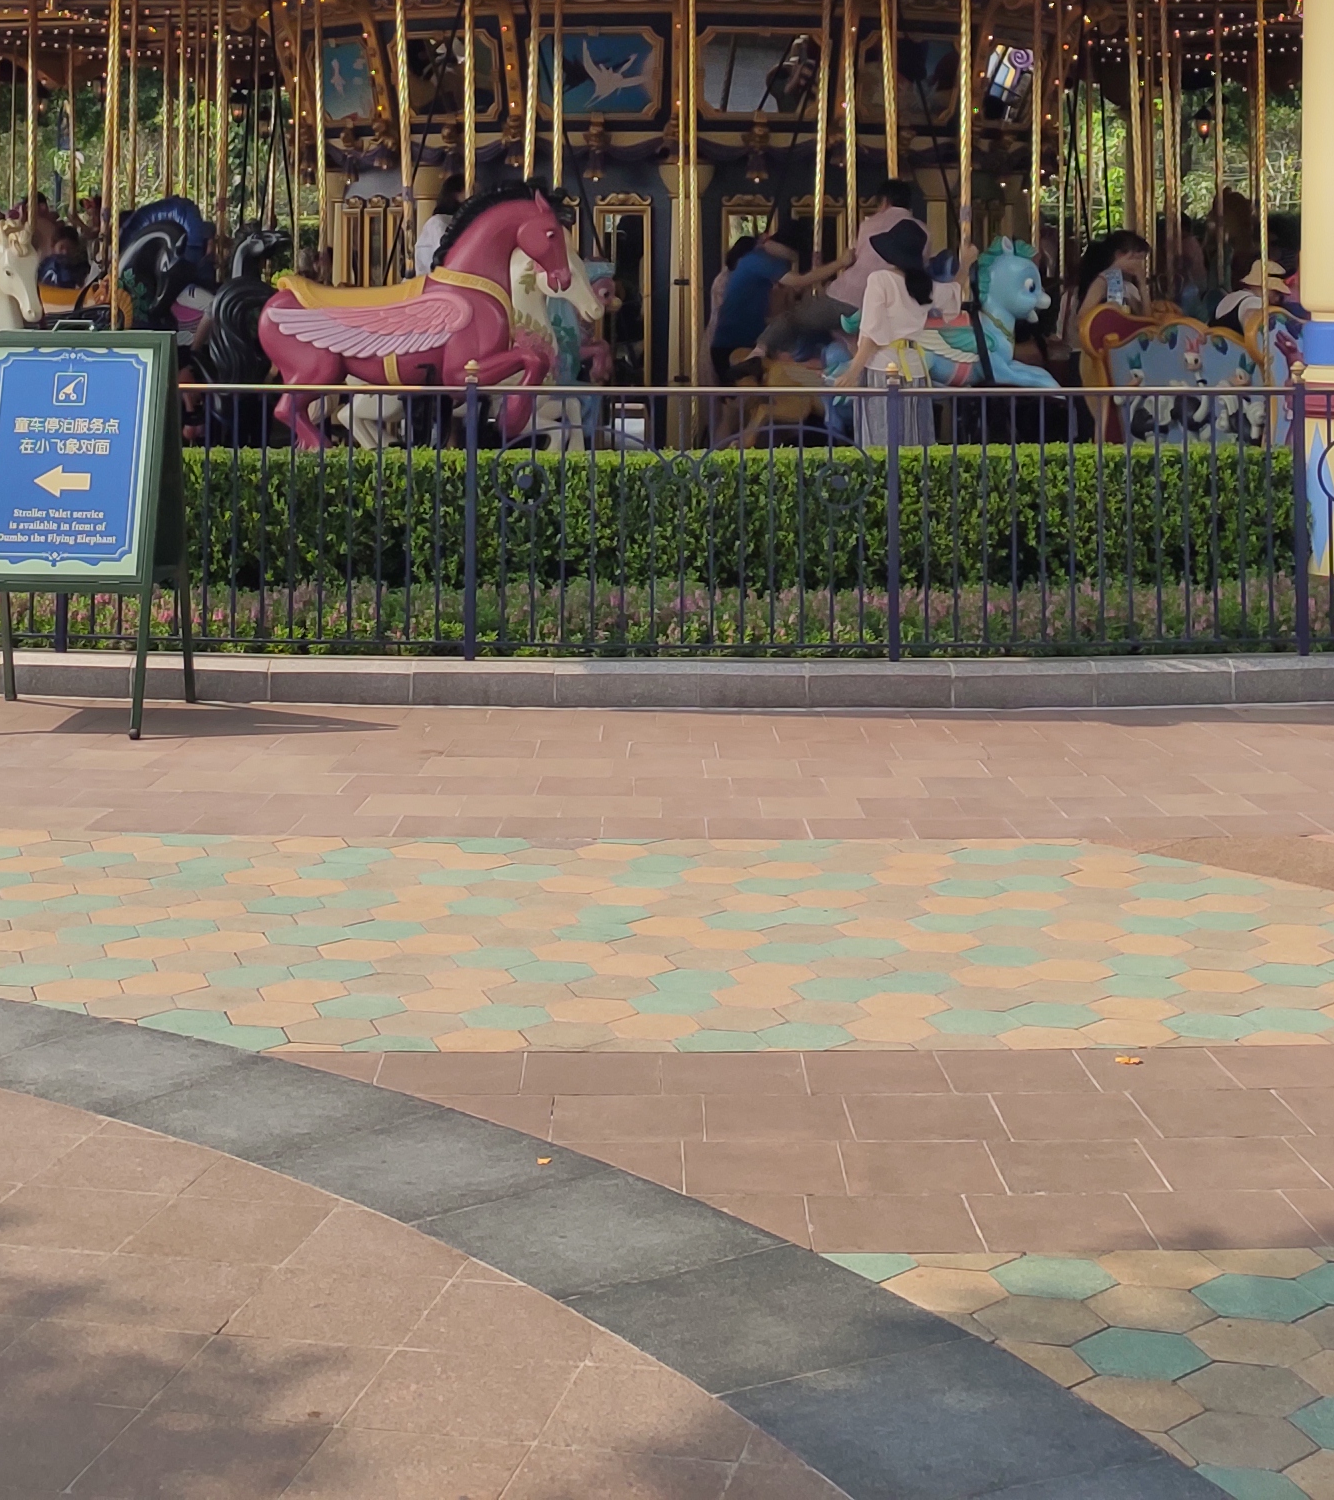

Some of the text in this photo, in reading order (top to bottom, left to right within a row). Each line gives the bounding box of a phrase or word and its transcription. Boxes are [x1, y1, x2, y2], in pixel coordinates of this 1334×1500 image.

[13, 417, 120, 435] 童车停泊服务点
[19, 438, 111, 455] 在小飞象对面
[13, 508, 104, 519] Stroller Valet service
[9, 520, 107, 531] is available in front of
[30, 533, 45, 542] the
[47, 534, 75, 545] Flying
[76, 534, 116, 546] Elephant
